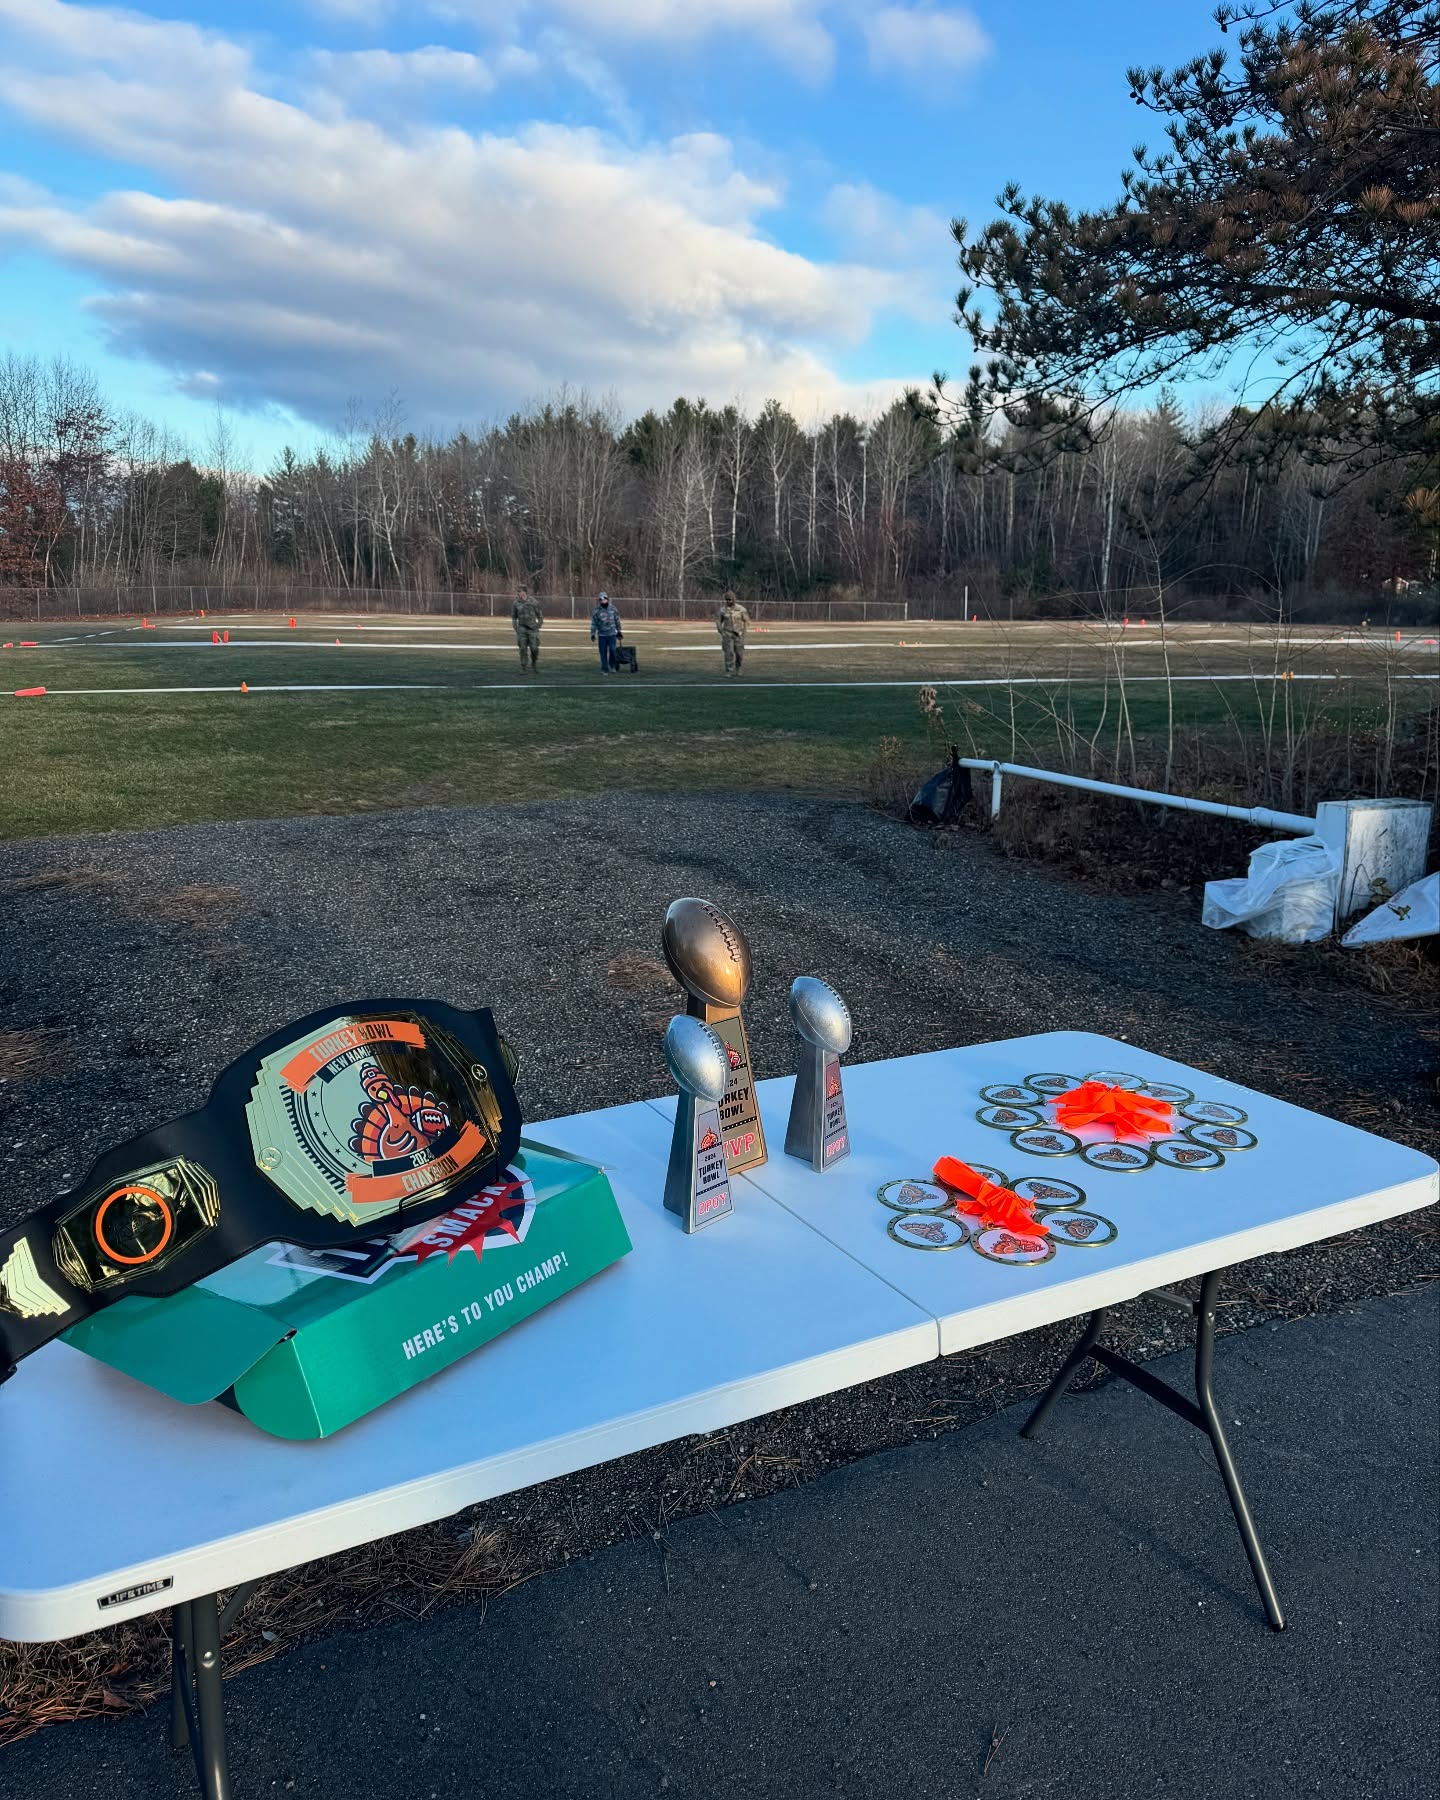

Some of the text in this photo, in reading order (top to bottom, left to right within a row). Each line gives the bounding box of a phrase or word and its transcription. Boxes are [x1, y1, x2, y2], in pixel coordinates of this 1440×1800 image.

[309, 1029, 358, 1062] TURKEY
[326, 1055, 348, 1075] NEW
[718, 1086, 749, 1108] URKEY
[720, 1103, 744, 1120] BOWL
[698, 1159, 723, 1178] TURKEY
[702, 1171, 720, 1184] BOWL
[423, 1184, 508, 1248] SMACK
[402, 1251, 569, 1360] HERE'S TO YOU CHAMP!
[107, 1580, 165, 1605] LIFETIME
